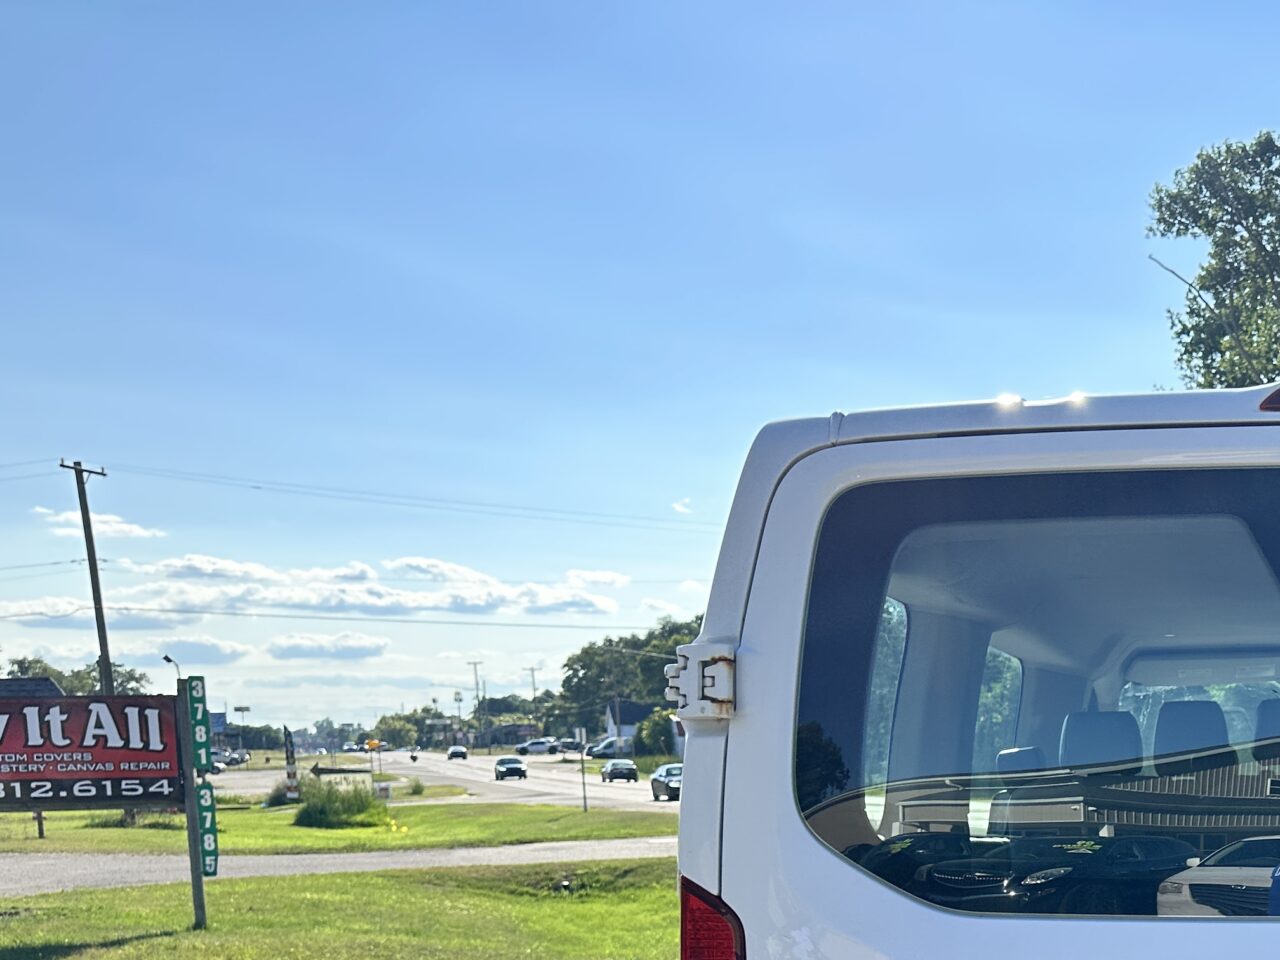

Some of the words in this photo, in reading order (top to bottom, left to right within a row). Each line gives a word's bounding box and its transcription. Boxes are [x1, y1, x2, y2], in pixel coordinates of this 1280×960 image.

[23, 705, 71, 746] It
[83, 702, 164, 751] All
[192, 680, 207, 765] 3781
[1, 763, 46, 773] STERY
[57, 763, 114, 772] CANVAS
[120, 762, 170, 771] REPAIR
[34, 752, 92, 761] COVERS
[0, 779, 173, 798] 12.6154
[200, 789, 216, 873] 3785
